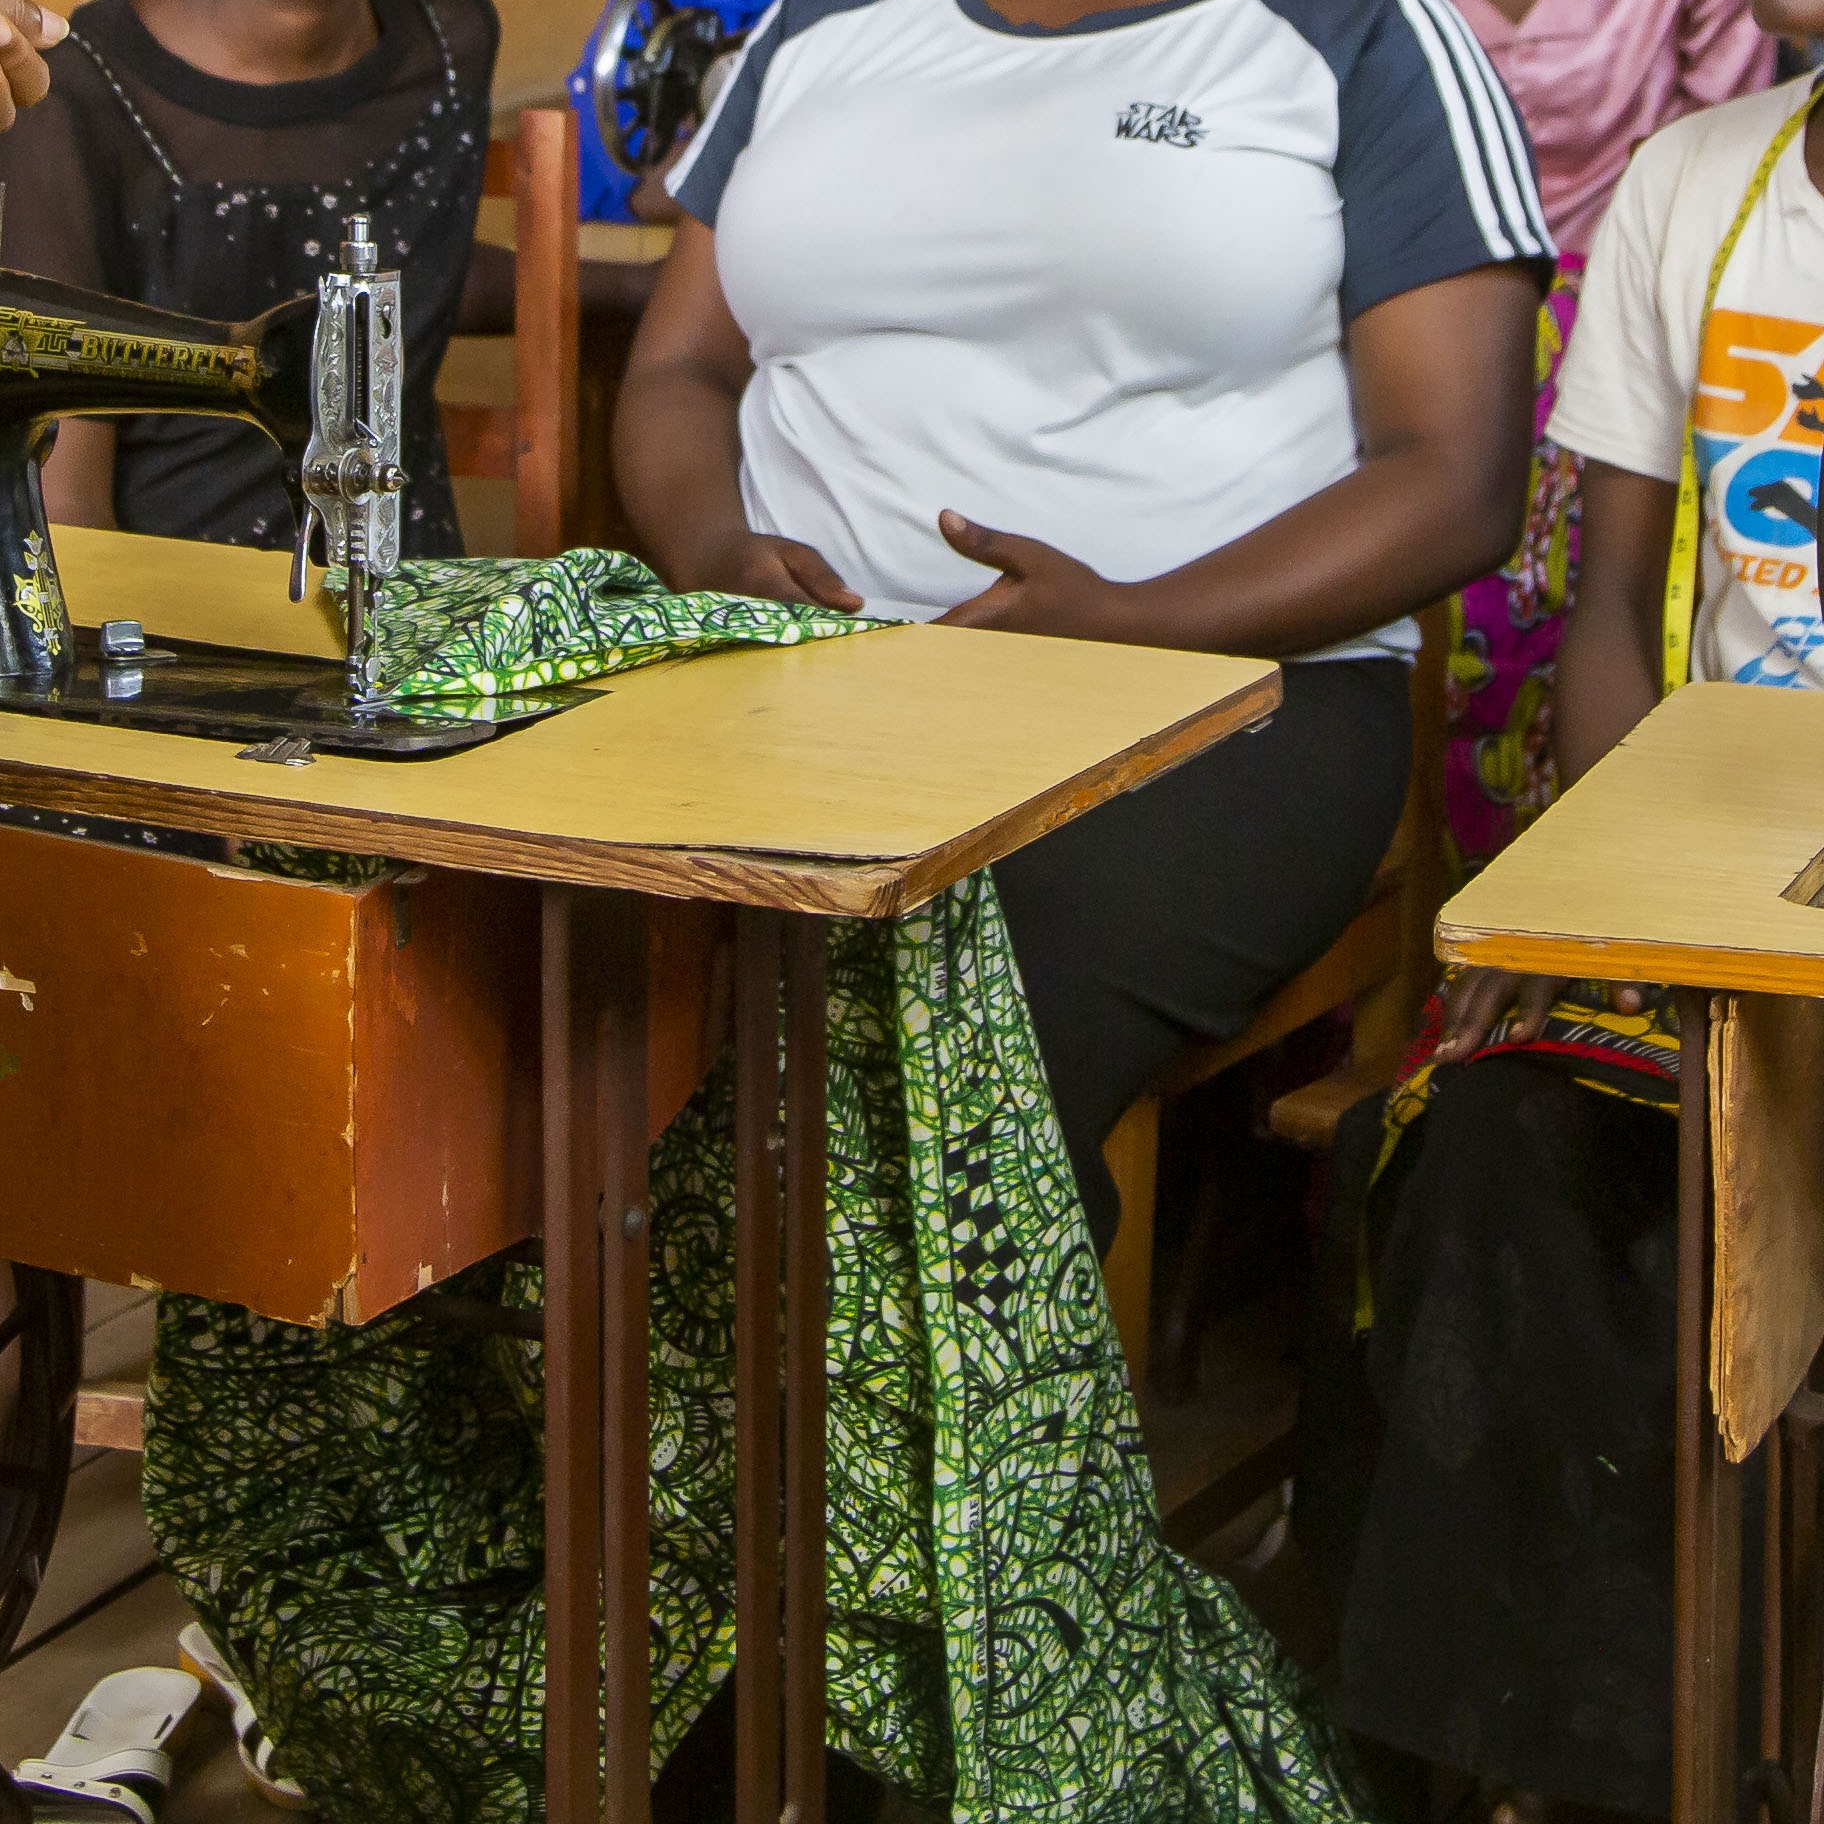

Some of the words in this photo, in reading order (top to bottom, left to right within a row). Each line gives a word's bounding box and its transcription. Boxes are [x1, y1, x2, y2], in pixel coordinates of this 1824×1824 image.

[1115, 112, 1209, 148] WARS
[1129, 102, 1203, 127] STAR
[79, 334, 238, 375] BUTTERFLY
